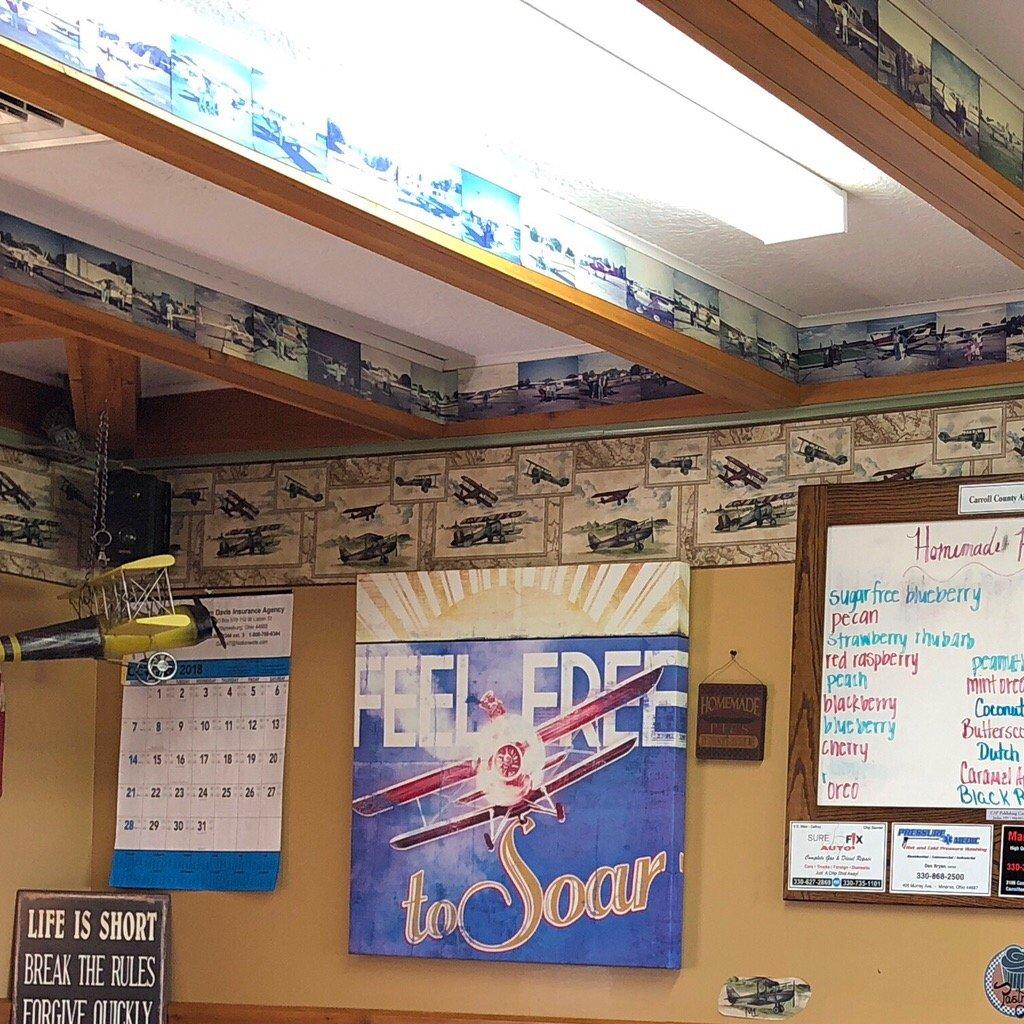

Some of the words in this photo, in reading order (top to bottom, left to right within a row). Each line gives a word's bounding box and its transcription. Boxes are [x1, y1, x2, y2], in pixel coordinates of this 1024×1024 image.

[969, 495, 992, 504] Carroll
[994, 494, 1017, 504] County
[907, 525, 1001, 563] Homemade
[905, 584, 982, 612] blueberry
[233, 607, 261, 615] Insurance
[262, 606, 285, 615] Agency
[831, 609, 879, 634] pecan
[827, 632, 908, 653] strawberry
[914, 629, 975, 649] rhubarb
[180, 664, 203, 676] 2018
[825, 652, 848, 670] red
[852, 651, 919, 675] raspberry
[156, 689, 162, 699] 1
[179, 688, 186, 698] 2
[203, 687, 209, 697] 3
[227, 686, 232, 696] 4
[250, 686, 256, 696] 5
[274, 685, 280, 695] 6
[827, 671, 868, 693] peach
[966, 674, 996, 695] mint
[353, 653, 483, 749] FEEL
[520, 650, 688, 749] FREE
[823, 694, 898, 719] blackberry
[131, 722, 138, 732] 7
[155, 722, 162, 732] 8
[178, 721, 184, 731] 9
[200, 721, 210, 731] 10
[224, 720, 233, 730] 11
[248, 719, 257, 730] 12
[271, 719, 280, 729] 13
[823, 716, 896, 741] blueberry
[129, 754, 138, 765] 14
[153, 754, 162, 764] 15
[176, 754, 185, 765] 16
[200, 754, 208, 764] 17
[223, 754, 232, 764] 18
[247, 753, 256, 764] 19
[269, 753, 278, 763] 20
[821, 740, 869, 763] cherry
[976, 742, 1020, 762] Dutch
[960, 761, 1011, 785] Caramel
[125, 787, 136, 798] 21
[150, 788, 161, 798] 22
[174, 788, 184, 798] 23
[198, 788, 208, 798] 24
[221, 788, 231, 798] 25
[245, 788, 255, 797] 26
[267, 787, 276, 797] 27
[827, 781, 859, 800] oreo
[957, 785, 1010, 806] Black
[124, 820, 134, 830] 28
[149, 820, 159, 831] 29
[173, 821, 184, 831] 30
[197, 821, 207, 831] 31
[807, 834, 830, 842] SURE
[845, 832, 863, 845] FIX
[402, 870, 458, 945] to
[456, 817, 668, 953] Soar
[27, 909, 65, 940] LIFE
[73, 909, 91, 941] IS
[99, 910, 158, 942] SHORT
[24, 953, 72, 986] BREAK
[78, 954, 105, 987] THE
[111, 955, 156, 988] RULES
